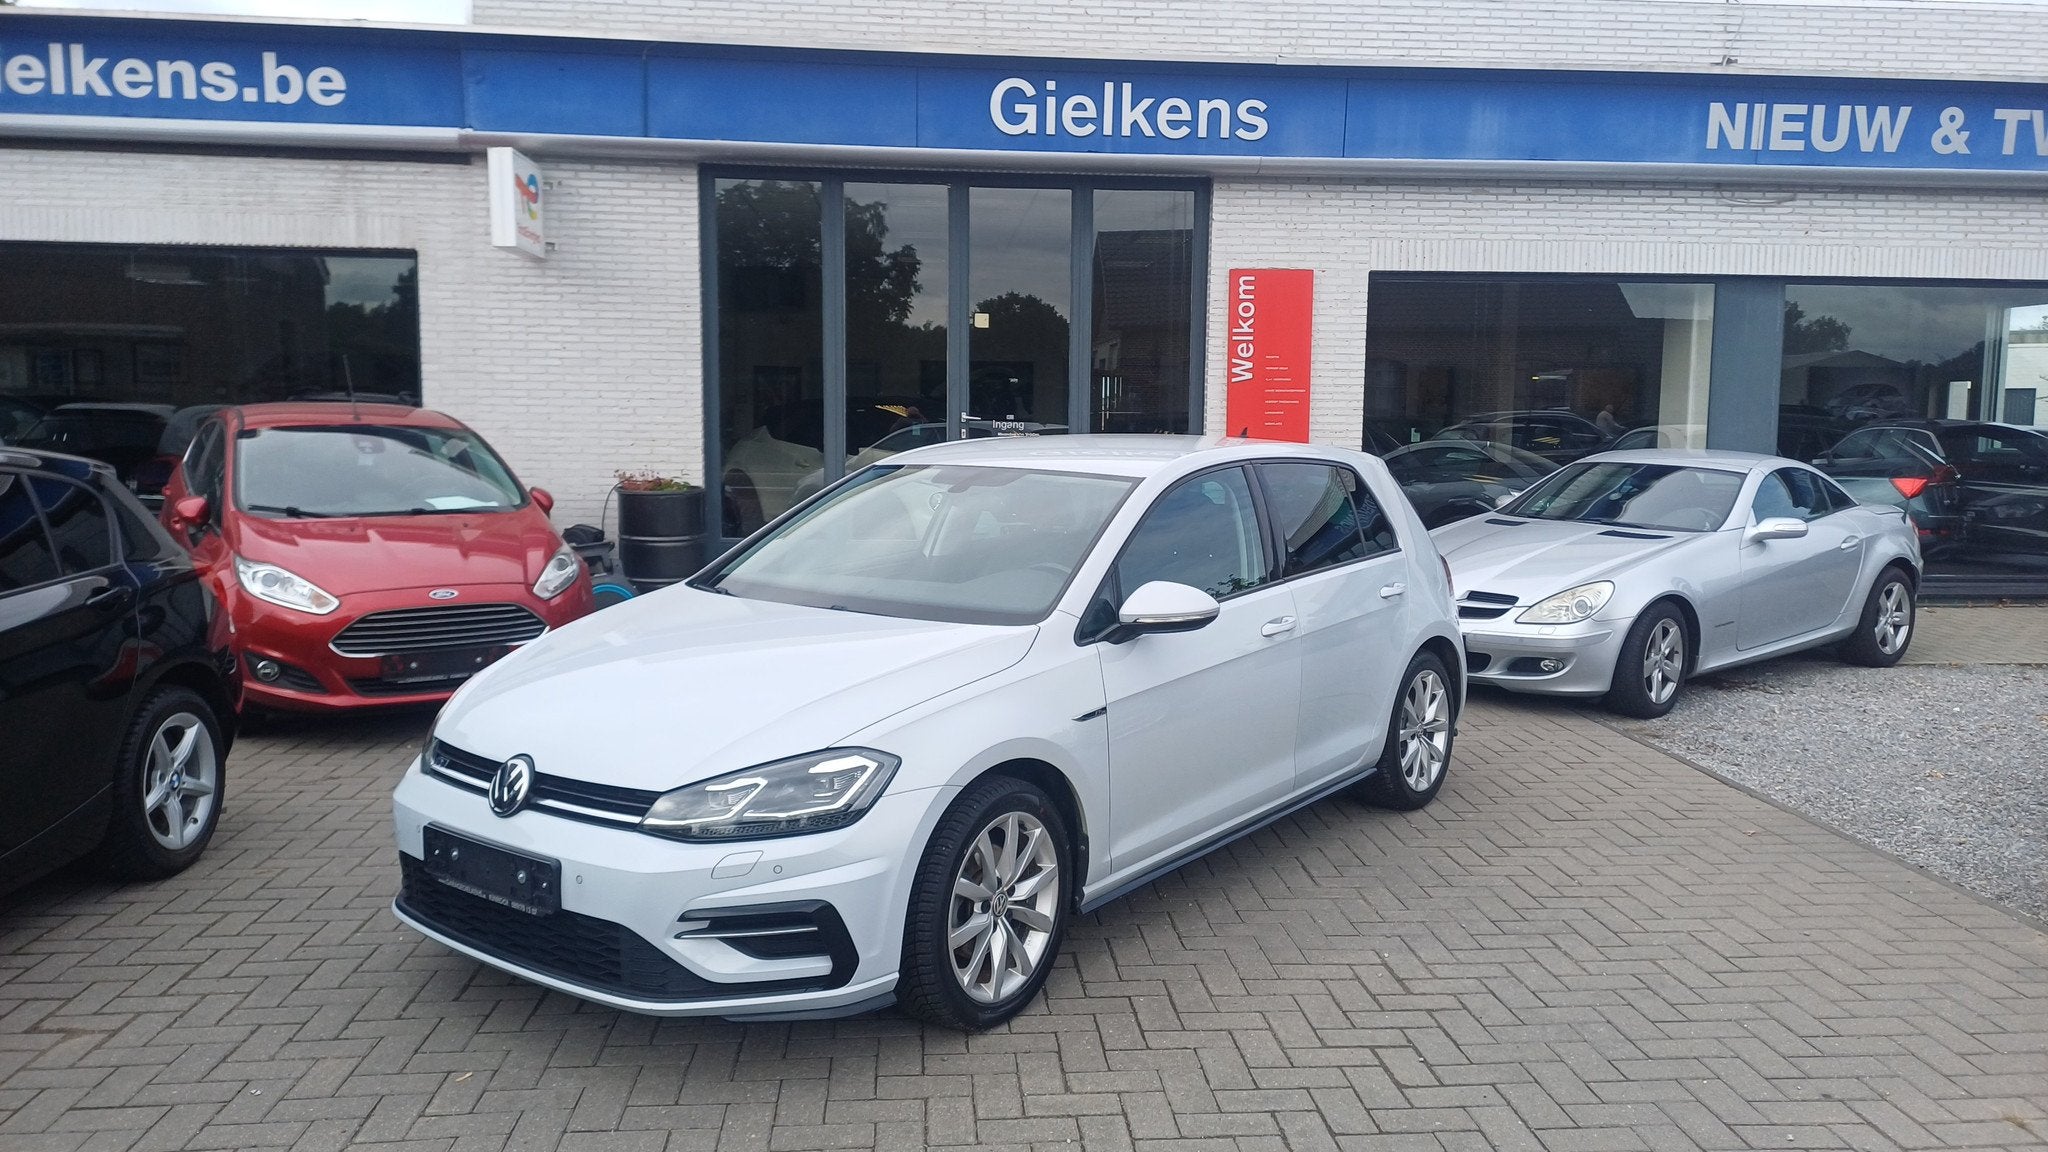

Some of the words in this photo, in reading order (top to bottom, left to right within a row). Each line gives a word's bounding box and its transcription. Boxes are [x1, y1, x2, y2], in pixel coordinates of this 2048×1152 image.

[0, 42, 347, 106] elkens.be
[989, 77, 1269, 141] Gielkens
[1705, 102, 1912, 153] NIEUW
[1930, 106, 1971, 155] &
[1231, 275, 1256, 383] Welkom
[992, 419, 1025, 431] Ingang
